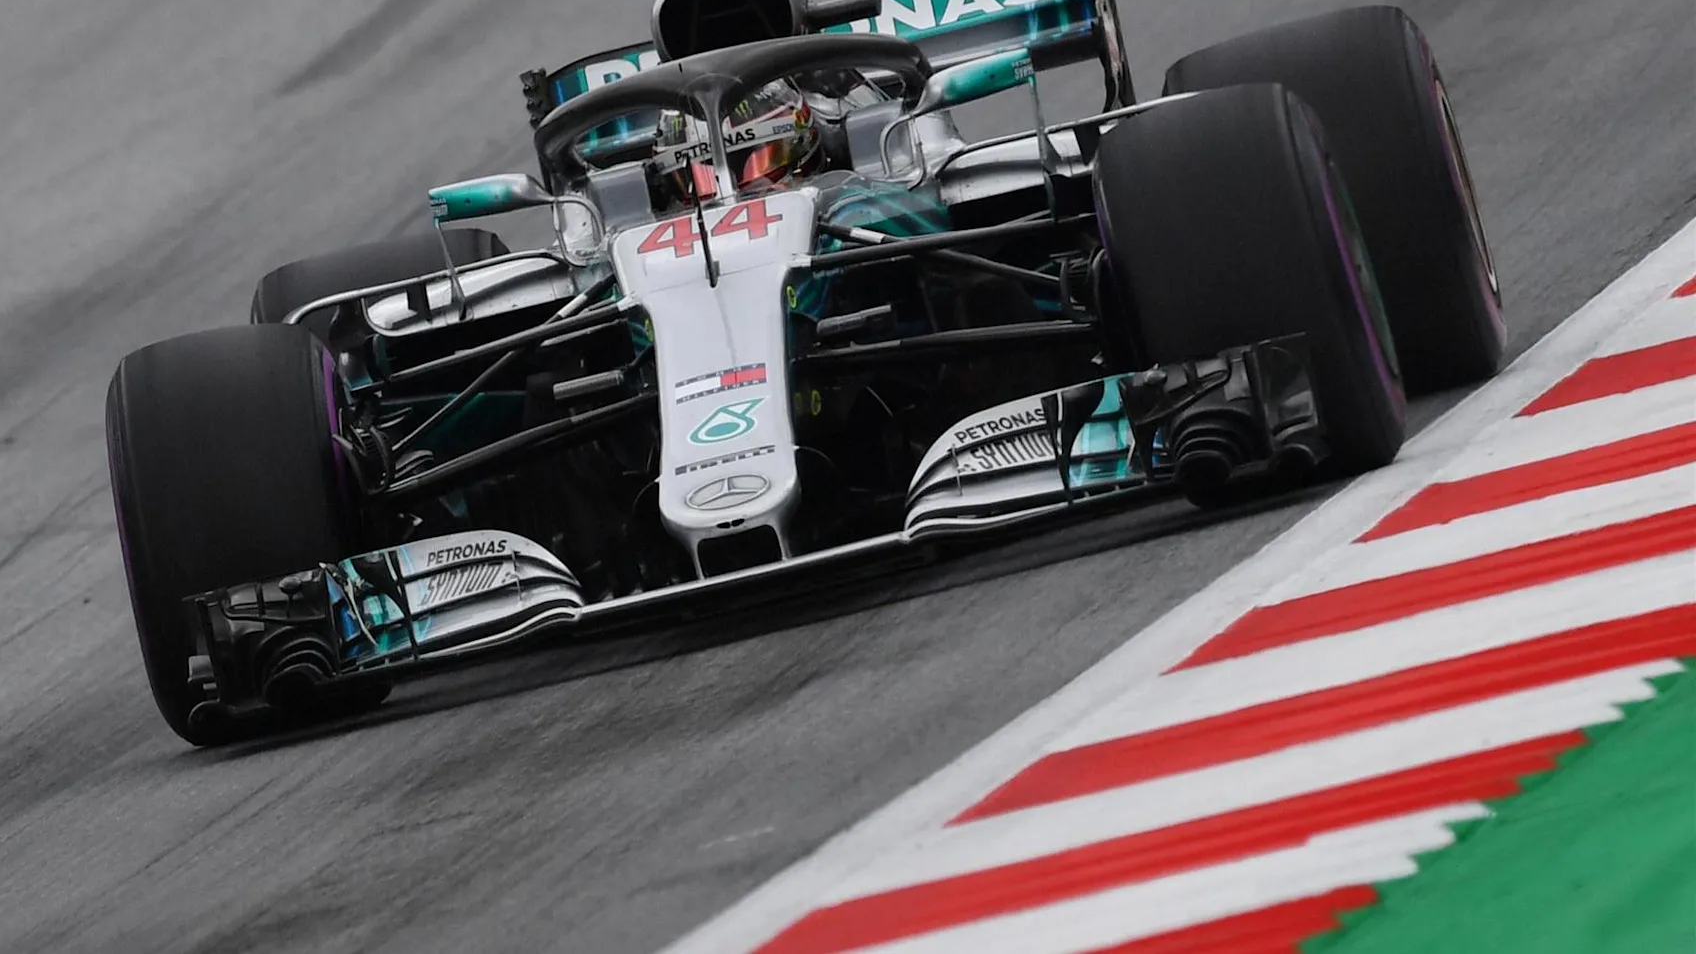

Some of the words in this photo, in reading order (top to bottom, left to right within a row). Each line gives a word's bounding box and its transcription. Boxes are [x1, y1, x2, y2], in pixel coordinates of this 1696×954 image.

[637, 199, 784, 259] 44
[953, 408, 1046, 444] PETRONAS
[426, 539, 508, 567] PETRONAS
